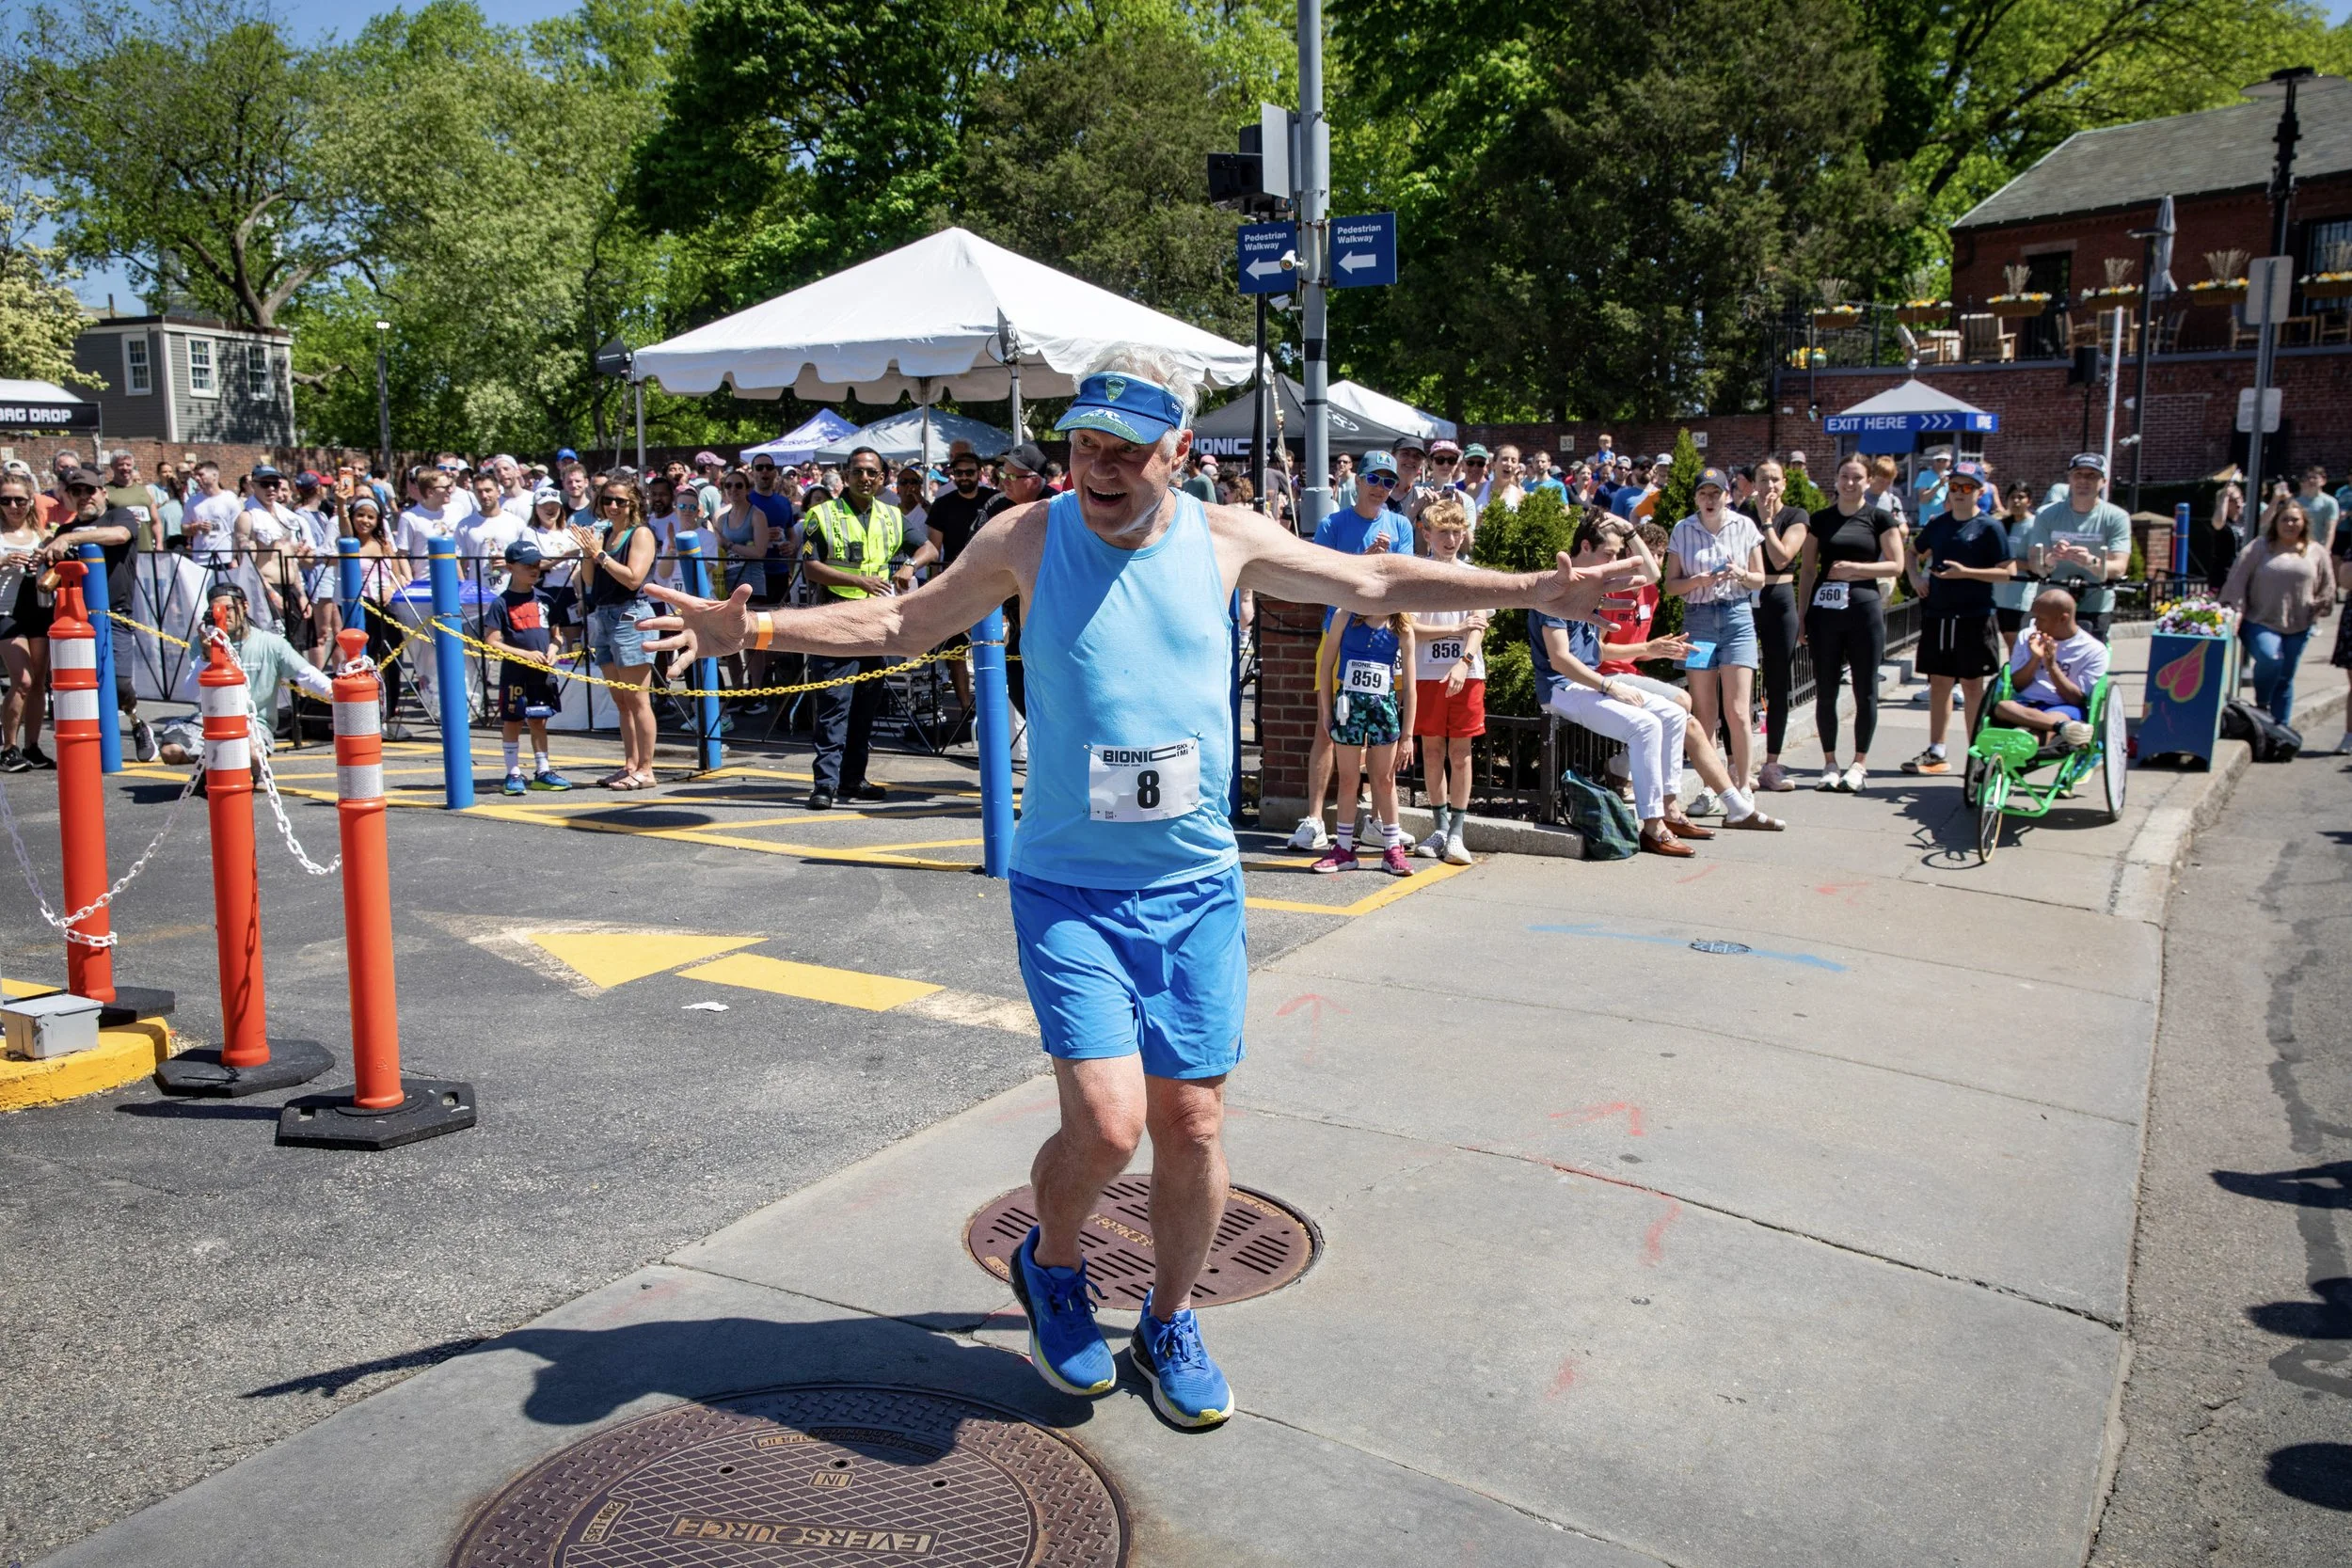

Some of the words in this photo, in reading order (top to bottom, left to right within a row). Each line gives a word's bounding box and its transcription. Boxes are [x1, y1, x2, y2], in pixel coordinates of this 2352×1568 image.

[1337, 224, 1381, 234] Pedestrian
[1244, 231, 1287, 242] Pedestrian
[1338, 234, 1374, 245] Walkway
[1245, 242, 1279, 251] Walkway
[29, 408, 72, 422] DROP
[1827, 417, 1860, 431] EXIT
[1864, 416, 1907, 430] HERE
[1819, 589, 1840, 601] 560
[1432, 642, 1460, 658] 858
[1352, 670, 1381, 688] 859
[1103, 745, 1176, 763] BIONIC
[1137, 769, 1160, 809] 8
[821, 1474, 842, 1485] IN
[676, 1518, 922, 1550] EVERSOURCE
